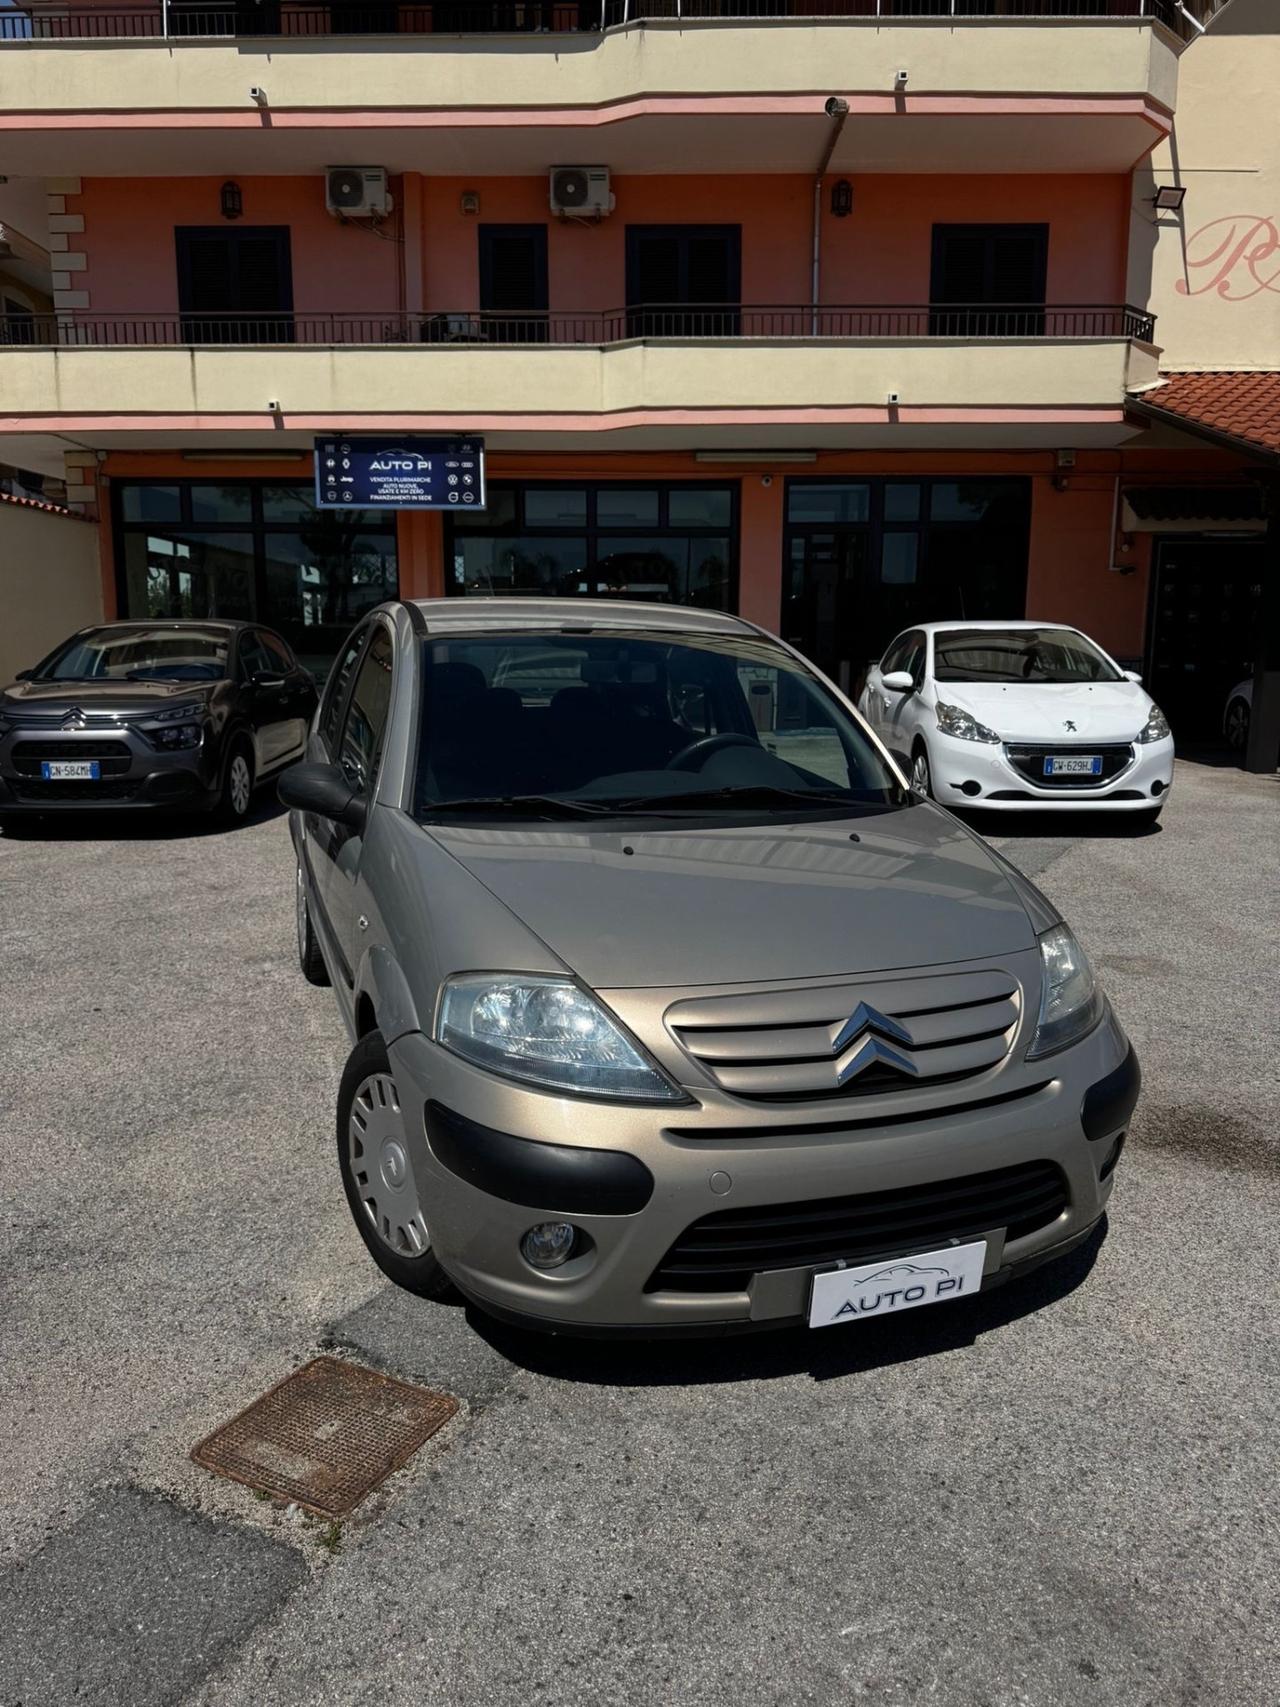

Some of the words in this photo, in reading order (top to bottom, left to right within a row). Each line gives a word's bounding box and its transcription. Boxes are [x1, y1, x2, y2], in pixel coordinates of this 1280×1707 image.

[369, 460, 413, 470] AUTO
[417, 460, 432, 470] PI
[832, 1285, 926, 1319] AUTO
[935, 1276, 965, 1298] PI
